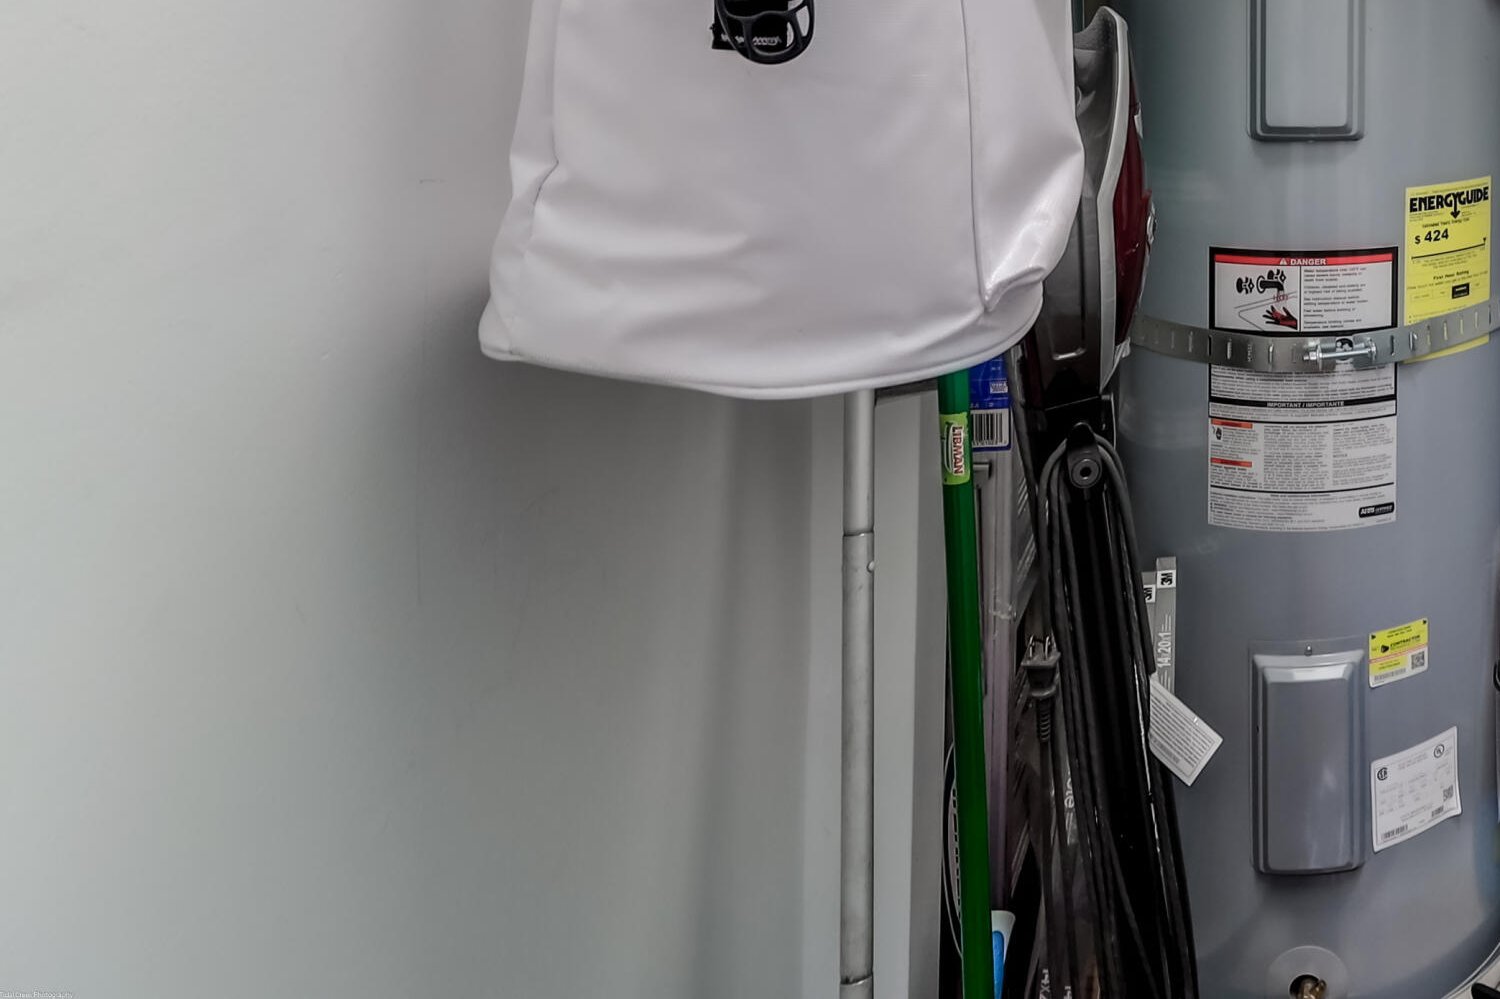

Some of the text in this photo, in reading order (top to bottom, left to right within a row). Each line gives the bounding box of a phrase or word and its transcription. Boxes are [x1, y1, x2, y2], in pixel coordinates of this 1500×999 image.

[1409, 186, 1489, 213] ENERGYGUIDE
[1424, 228, 1449, 242] 424
[1290, 258, 1326, 266] DANGER
[952, 425, 964, 474] LIBMAN
[1160, 573, 1173, 586] 3M
